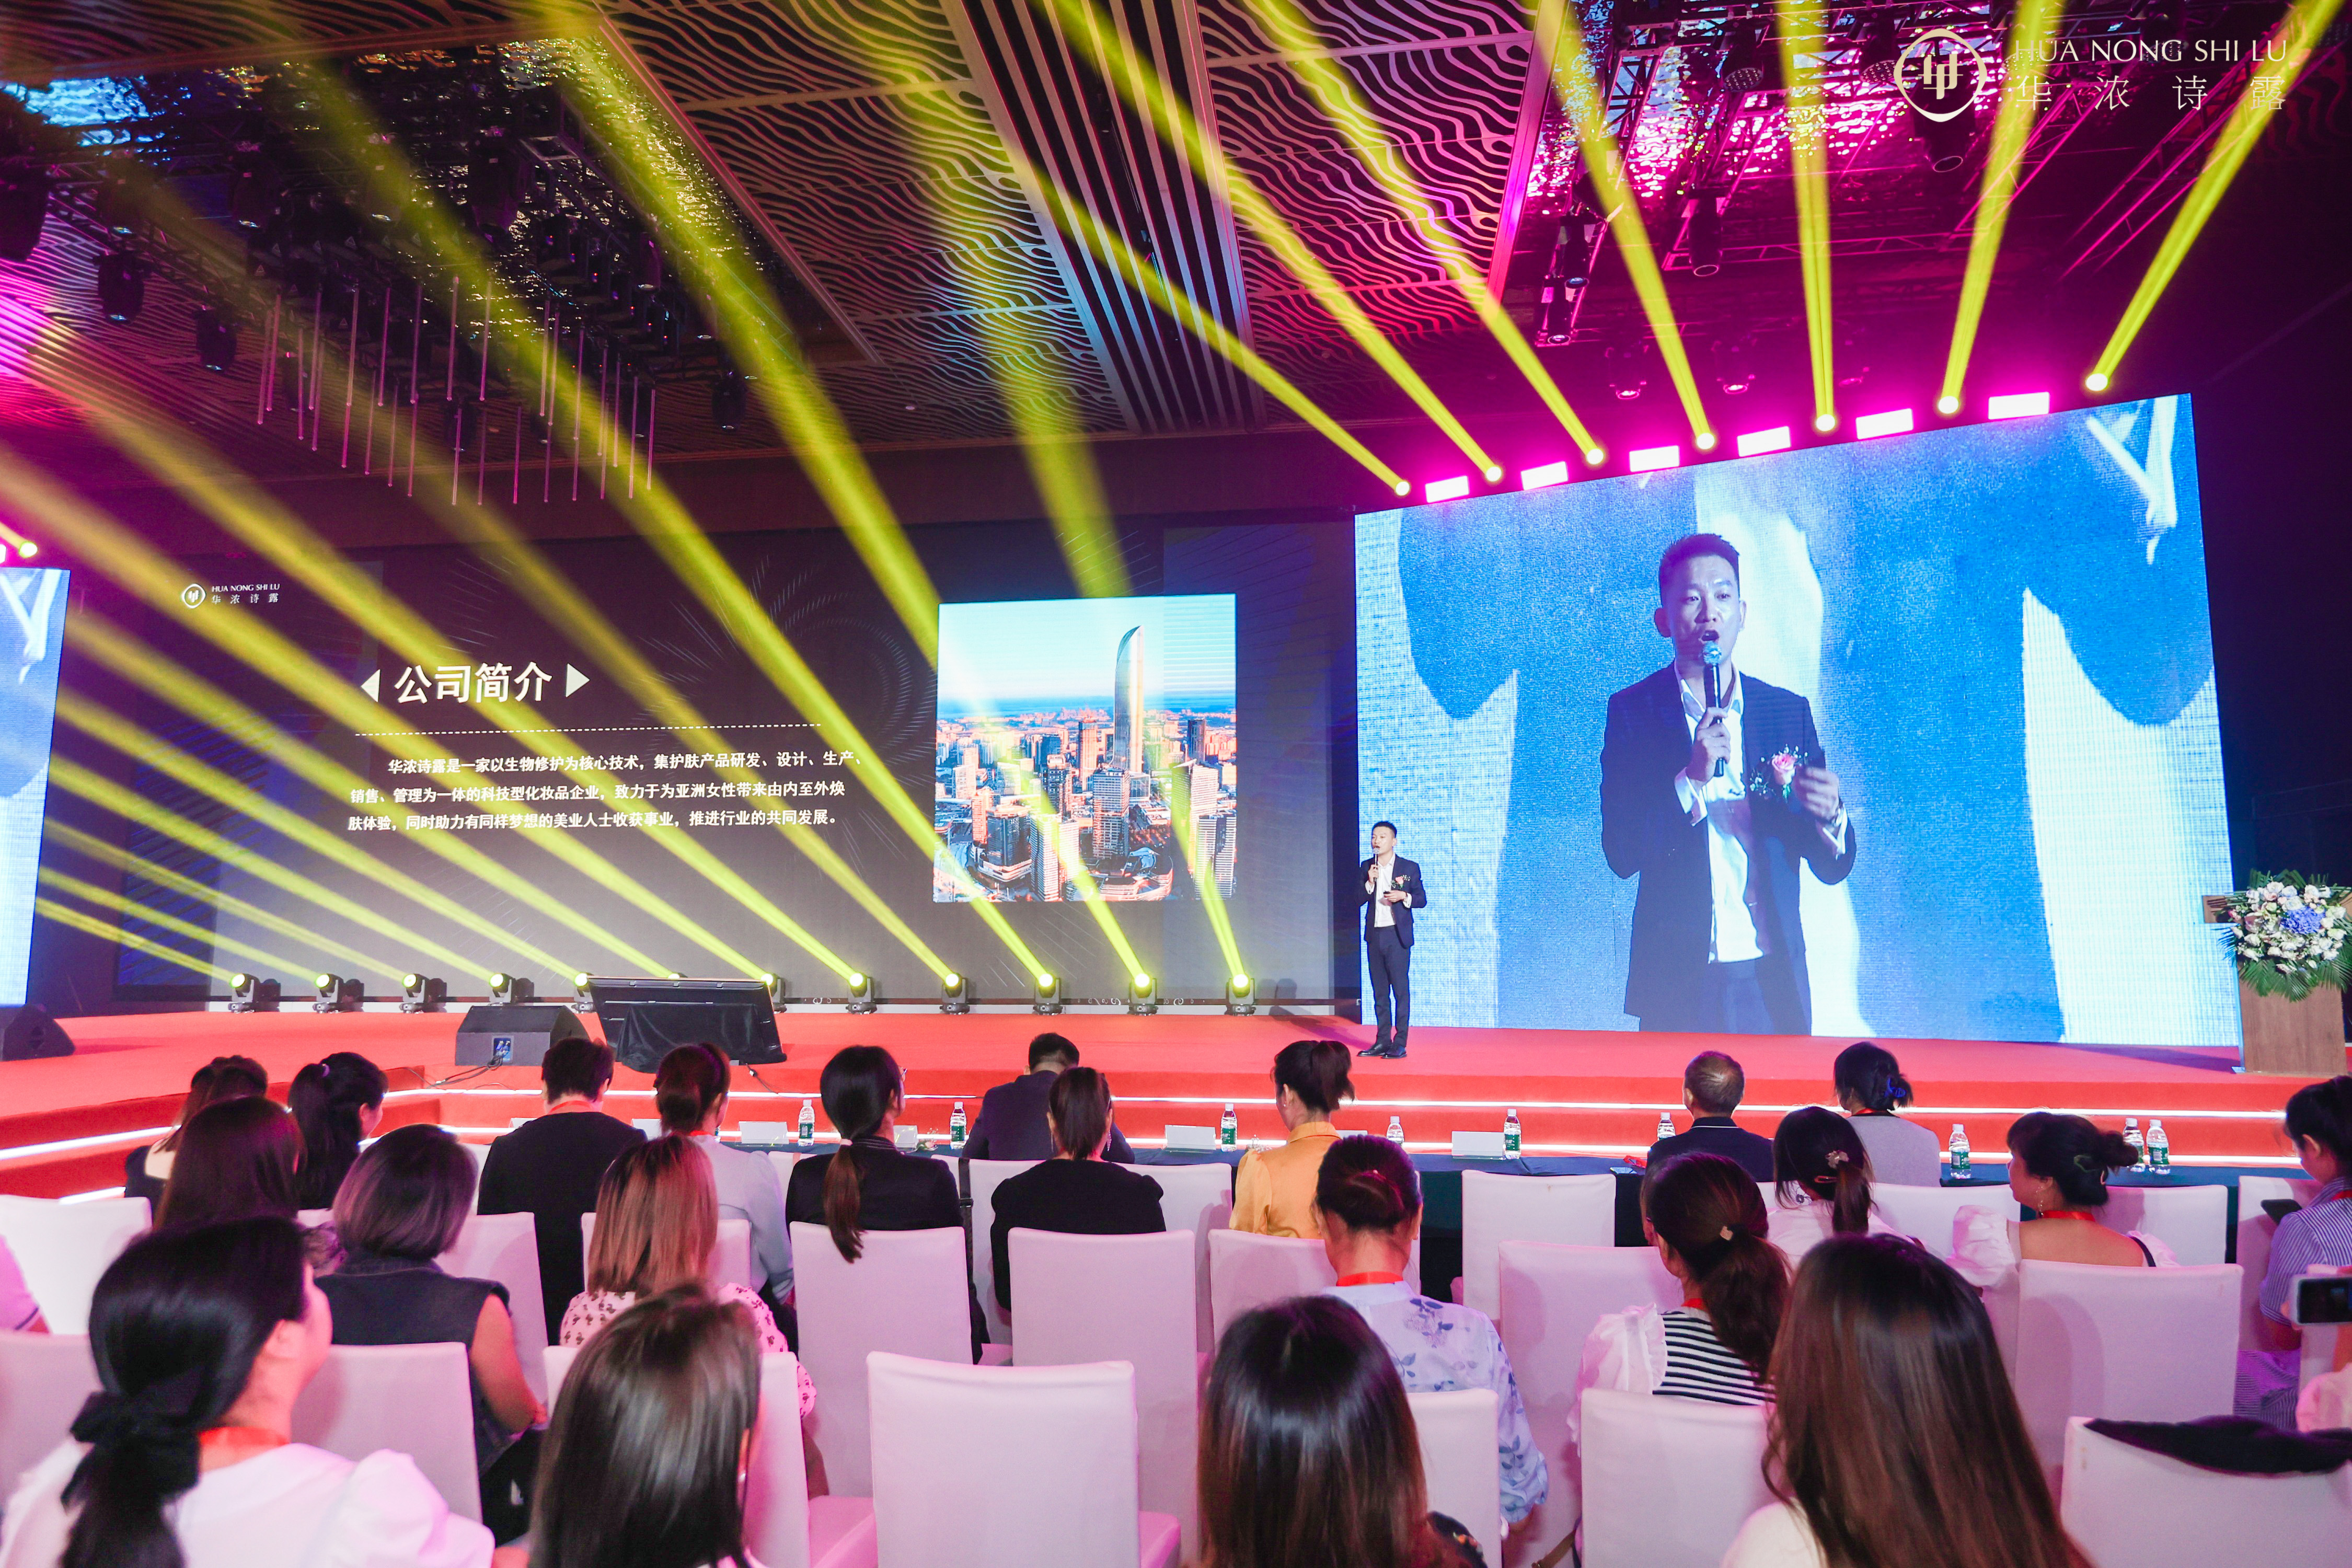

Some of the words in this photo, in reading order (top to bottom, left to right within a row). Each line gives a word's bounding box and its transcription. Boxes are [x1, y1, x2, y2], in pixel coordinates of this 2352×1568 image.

[211, 593, 279, 604] 华浓诗露
[395, 661, 552, 704] 公司简介
